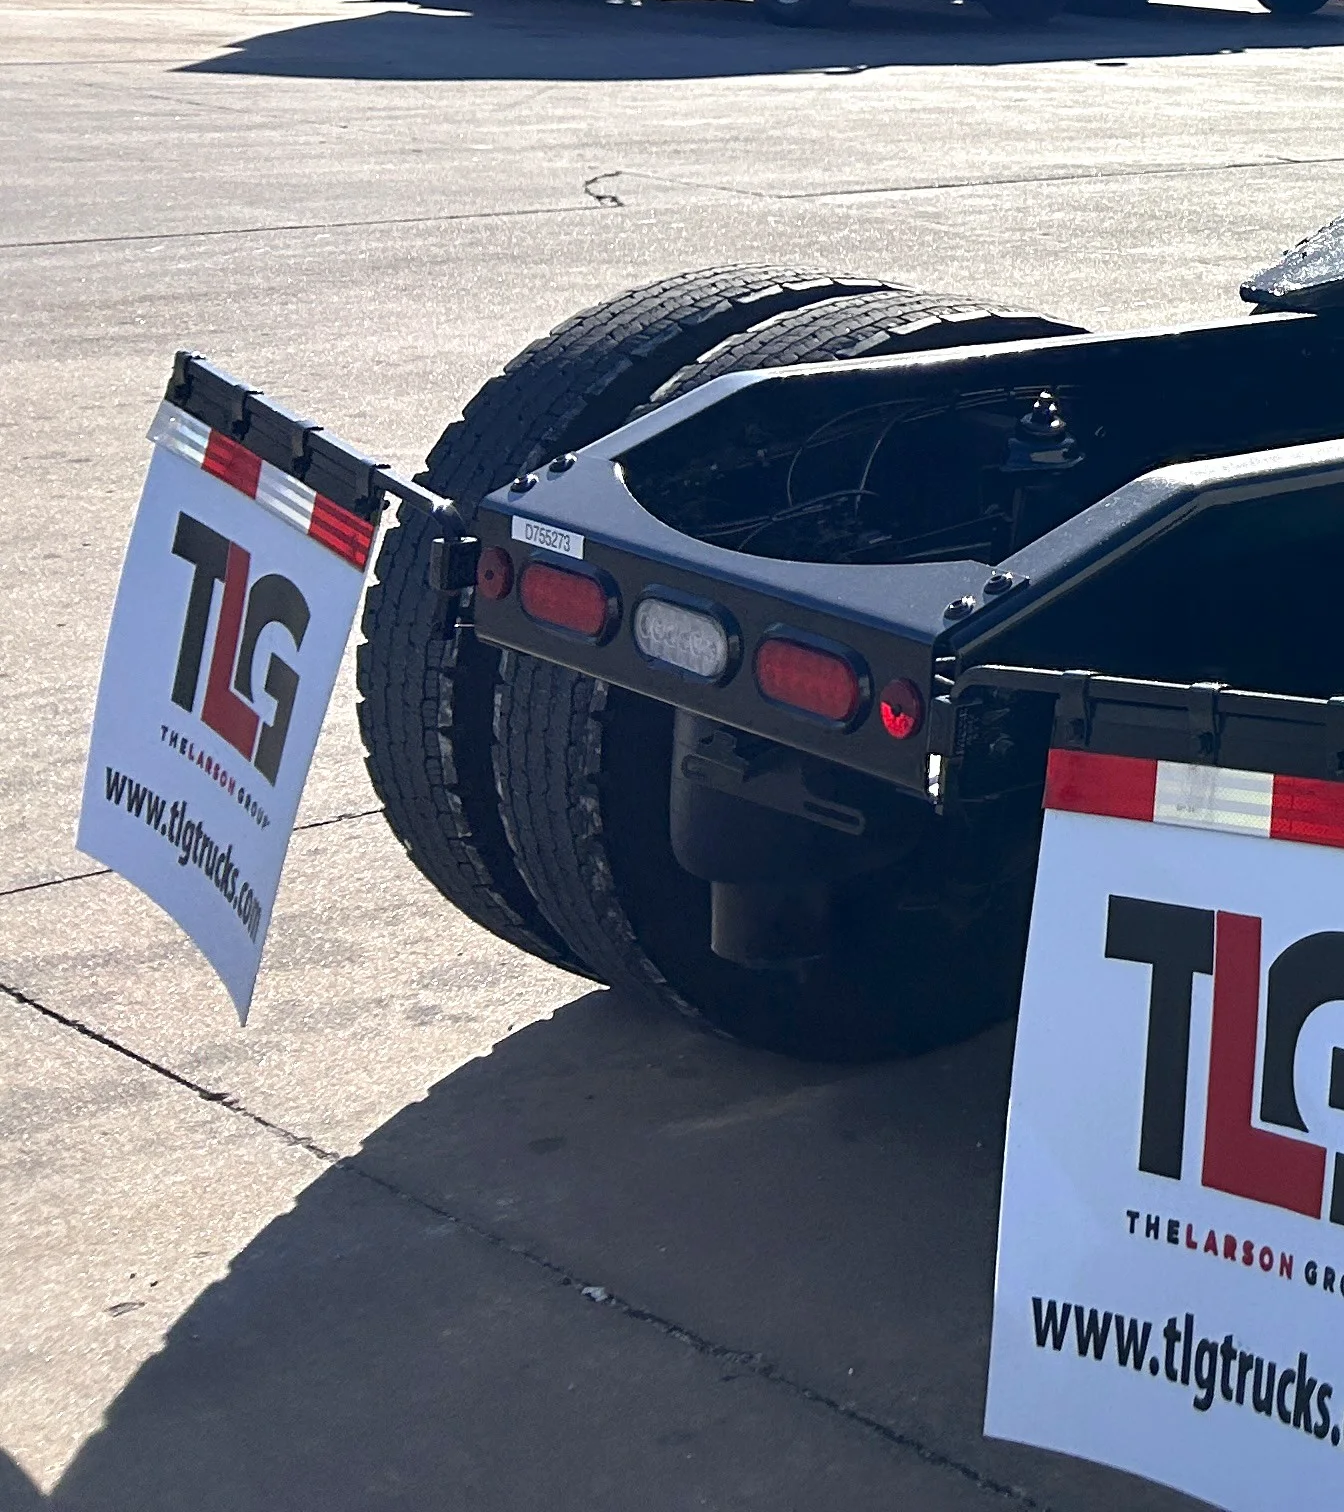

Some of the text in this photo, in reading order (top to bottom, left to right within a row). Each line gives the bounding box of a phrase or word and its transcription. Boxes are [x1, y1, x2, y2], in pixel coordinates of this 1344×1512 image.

[525, 523, 571, 553] D755273
[171, 510, 311, 787] TLG
[106, 766, 262, 944] www.tlgtrucks.com
